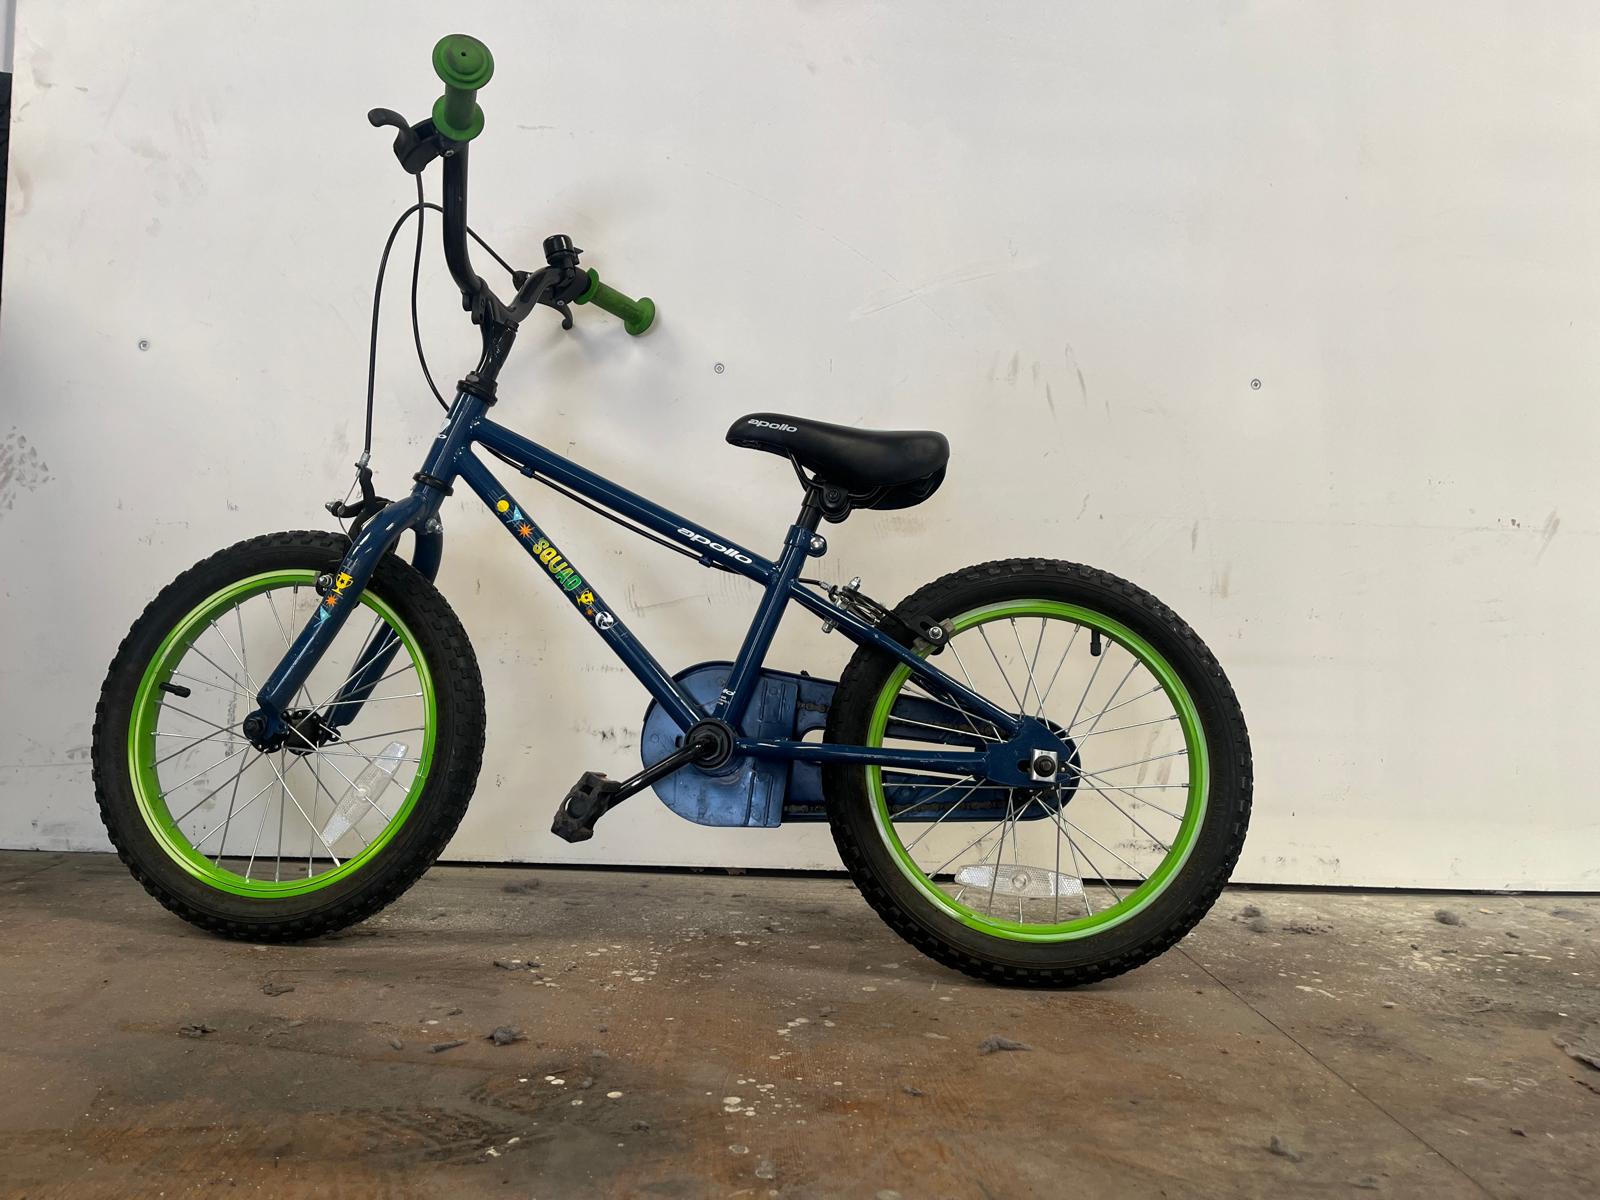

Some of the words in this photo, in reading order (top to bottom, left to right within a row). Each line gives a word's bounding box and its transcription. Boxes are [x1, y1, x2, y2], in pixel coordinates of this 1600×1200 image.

[748, 418, 798, 433] apollo
[677, 528, 753, 564] apollo
[532, 538, 582, 592] SQUAD
